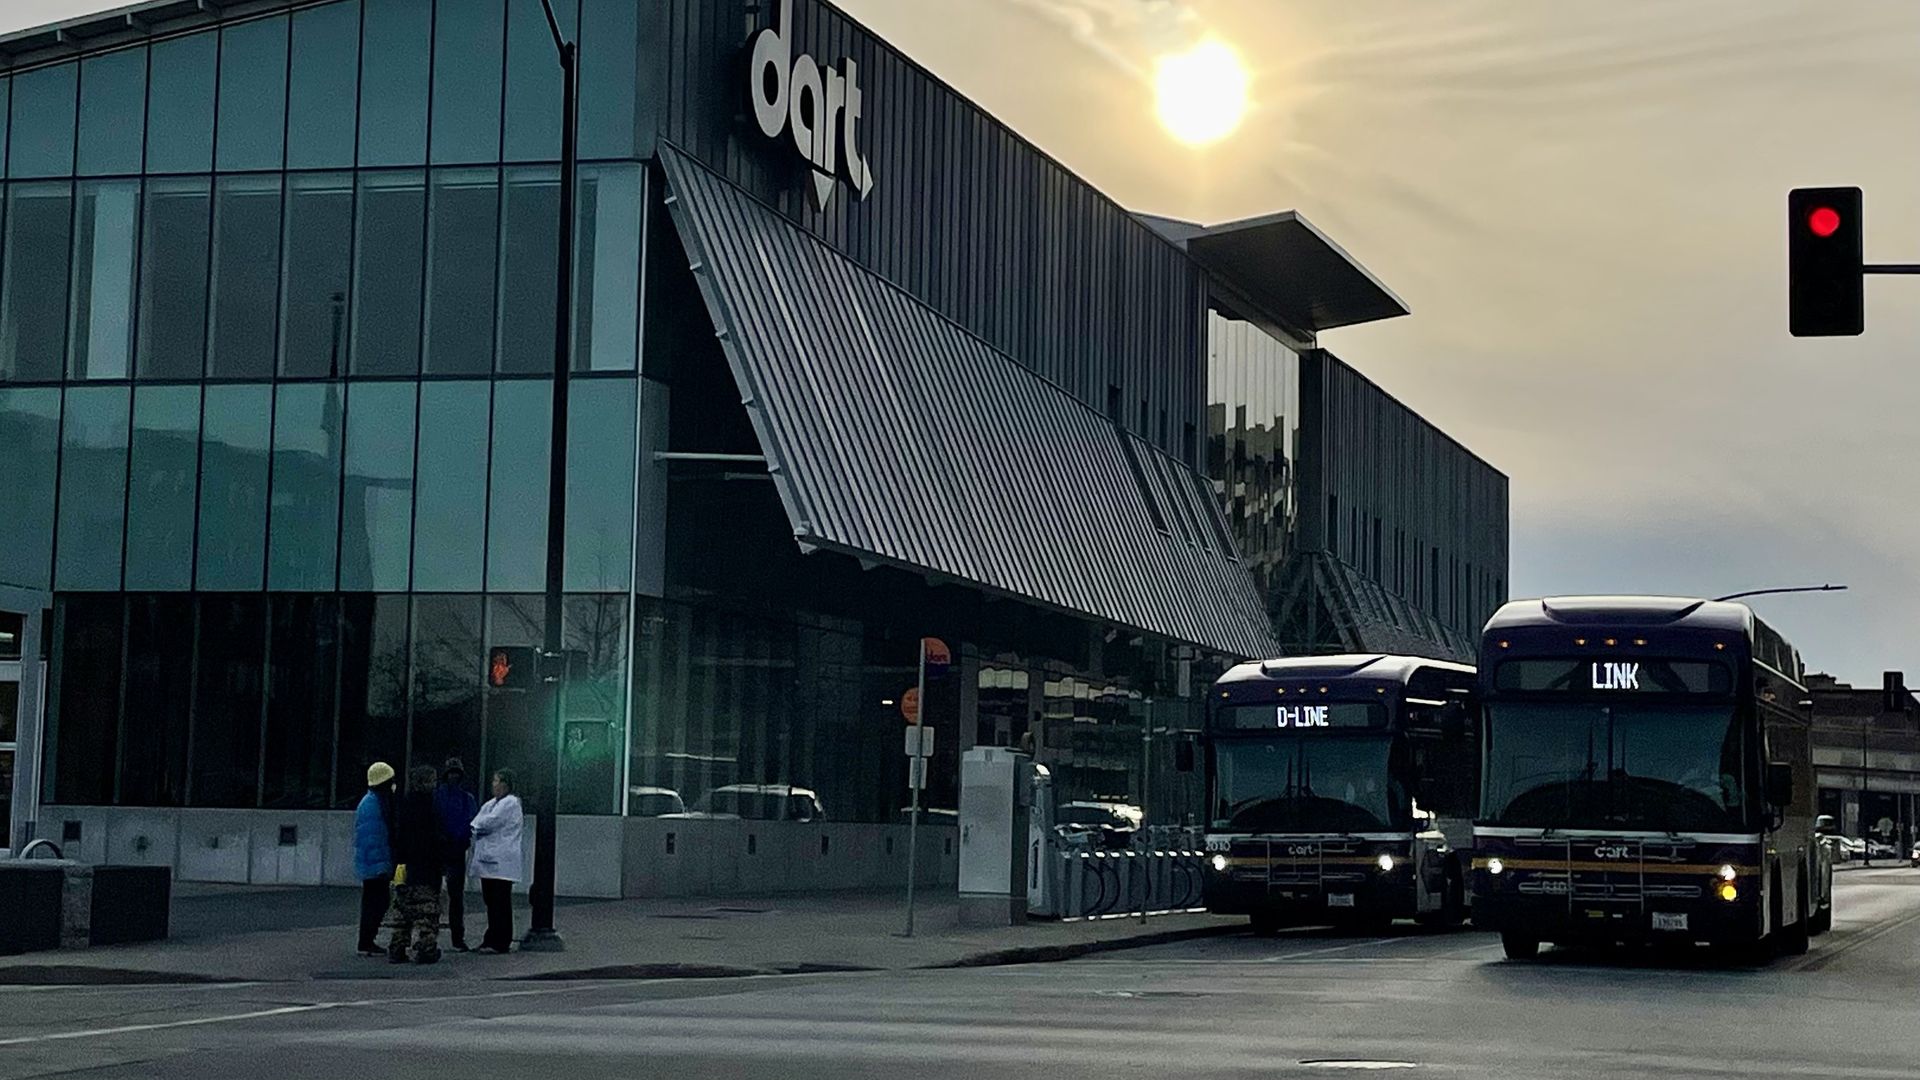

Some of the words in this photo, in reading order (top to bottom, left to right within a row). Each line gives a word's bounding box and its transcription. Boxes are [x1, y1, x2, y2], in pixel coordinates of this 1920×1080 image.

[751, 0, 873, 201] dart
[1592, 662, 1639, 689] LINK
[1277, 706, 1329, 727] D-LINE
